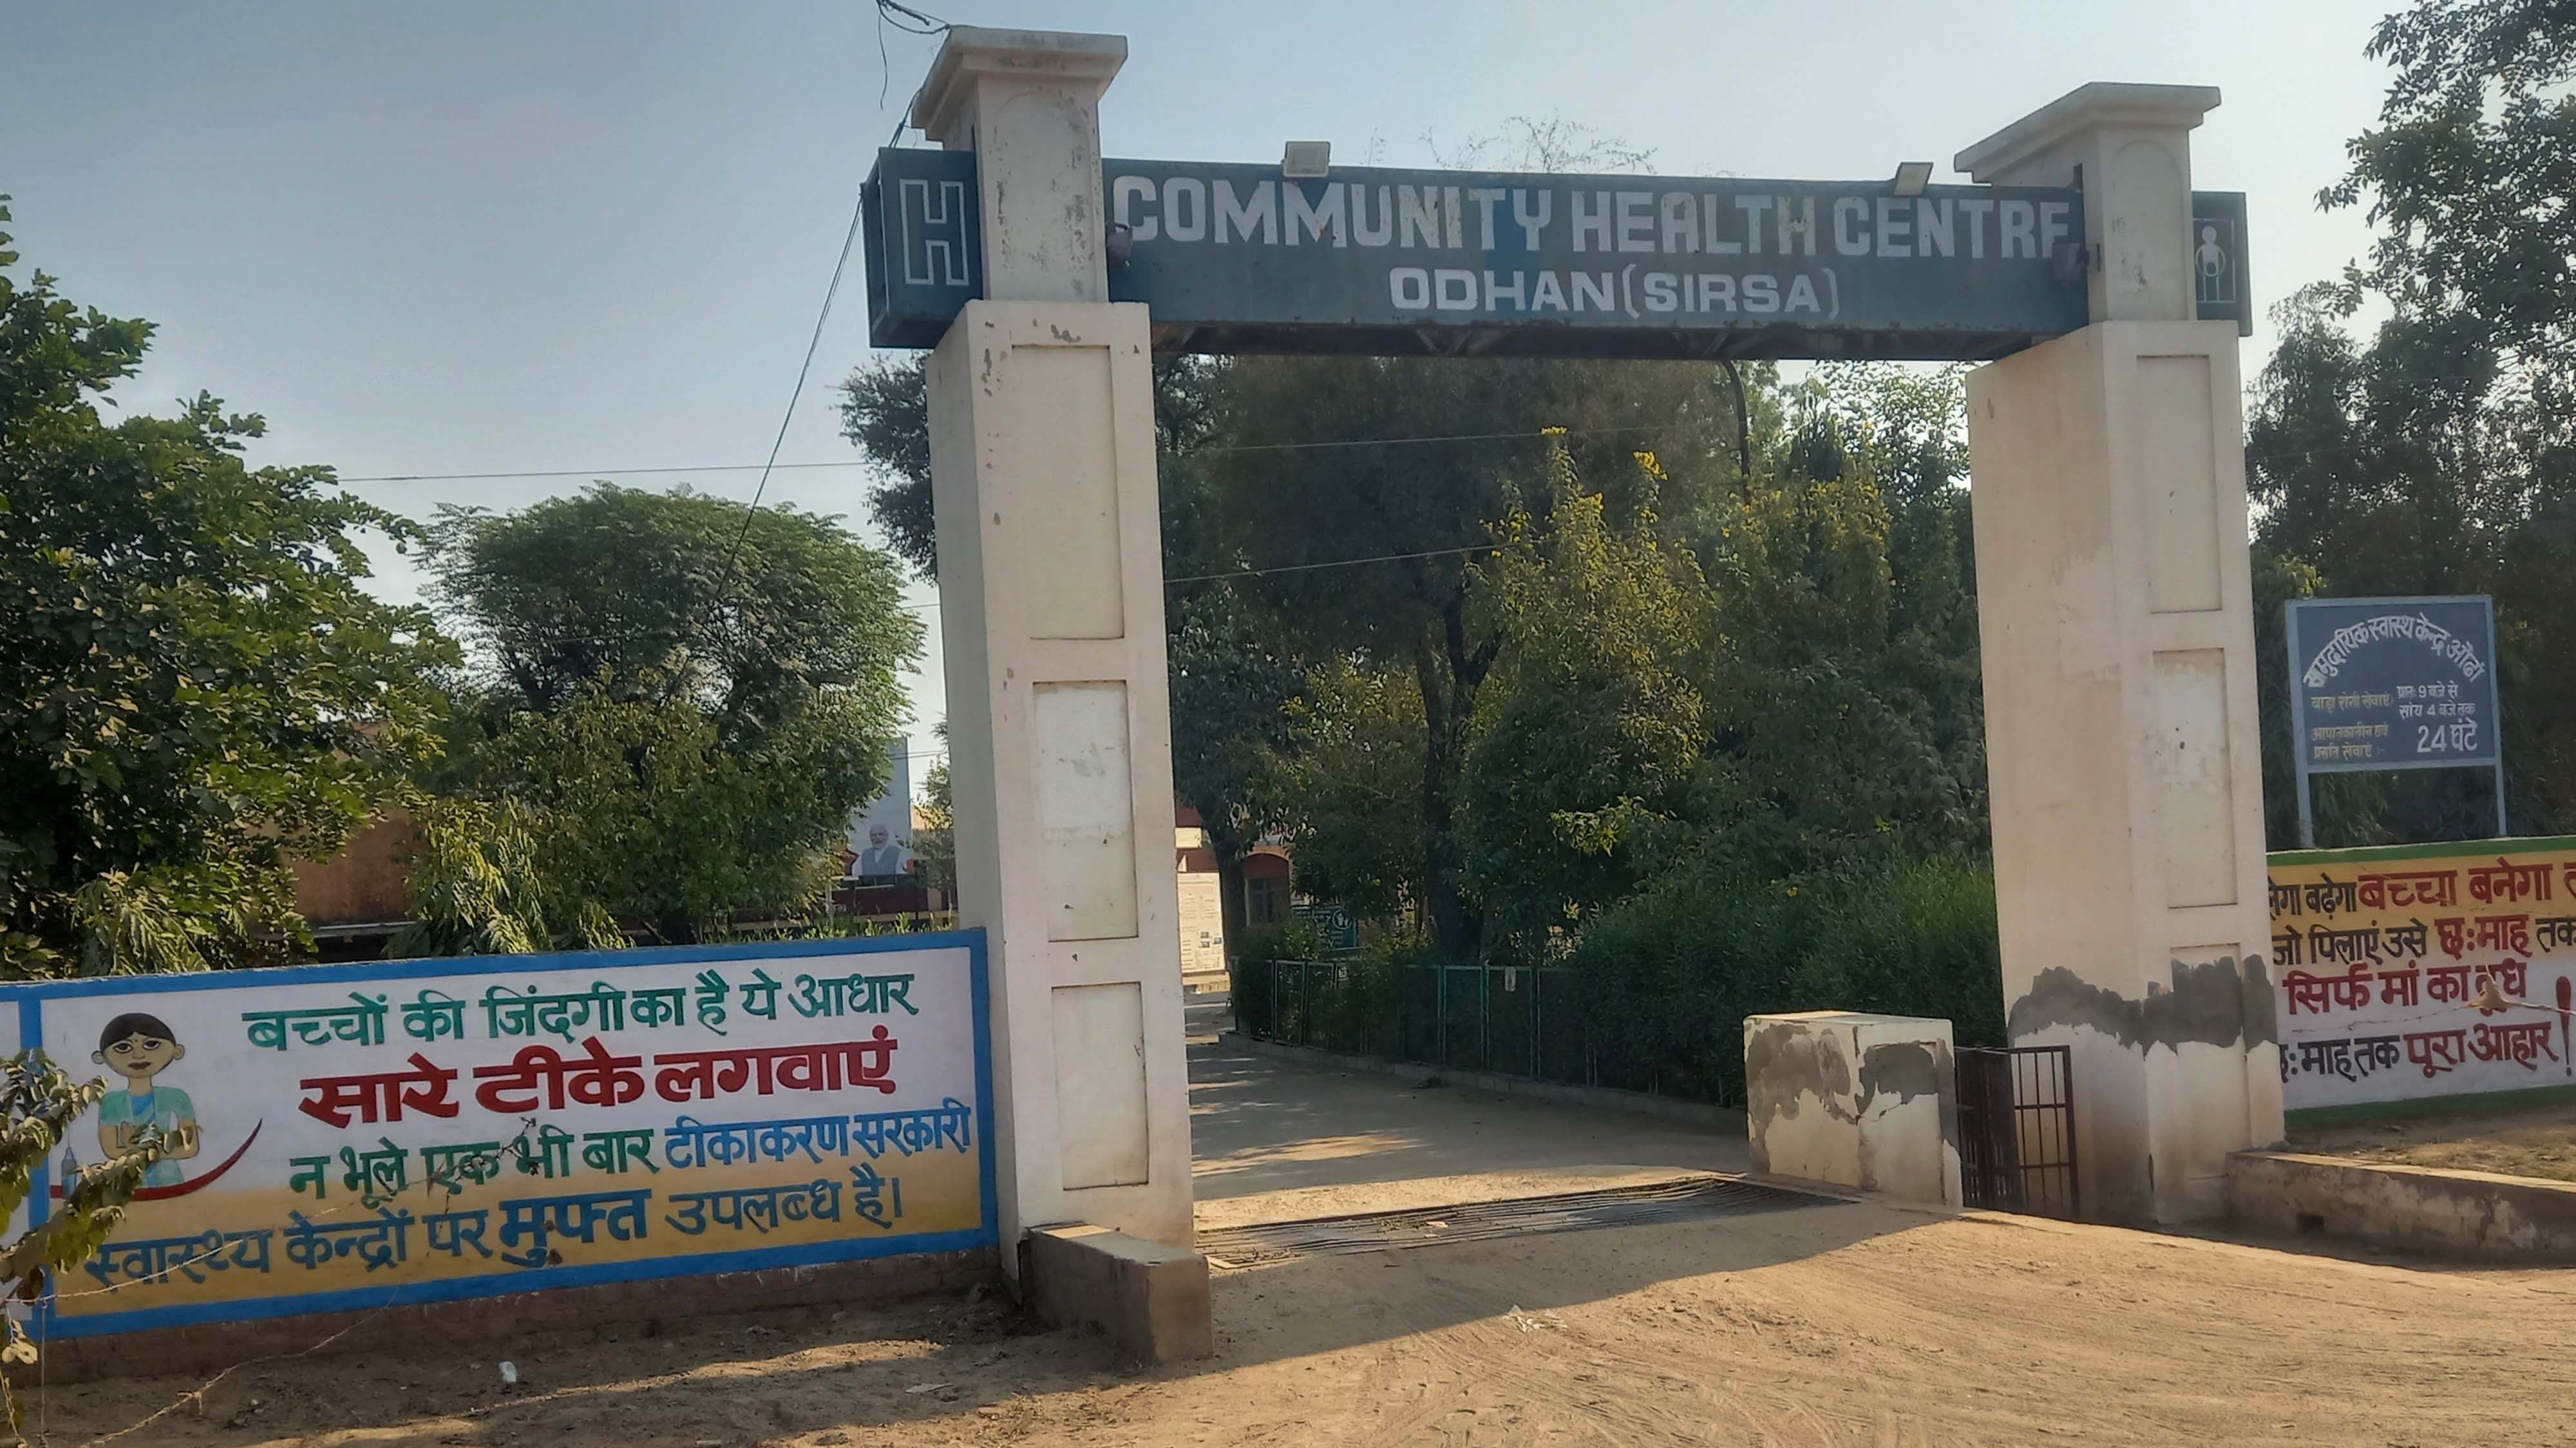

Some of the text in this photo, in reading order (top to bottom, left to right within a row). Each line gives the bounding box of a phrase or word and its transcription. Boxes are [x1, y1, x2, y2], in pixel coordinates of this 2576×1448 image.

[1113, 175, 2070, 258] COMMUNITY HEALTH CENTRE
[2418, 686, 2427, 698] 9
[2427, 704, 2436, 716] 4
[2417, 716, 2478, 753] 24 घंटे
[2304, 873, 2357, 920] बढ़ेगा
[2358, 870, 2458, 910] बच्चा
[2468, 857, 2553, 904] बनेगा
[2308, 920, 2383, 966] पिलाएं
[2382, 917, 2428, 958] उसे
[242, 968, 919, 1051] बच्चों की जिंदगी का है ये आधार
[2282, 962, 2373, 1015] सिर्फ
[2378, 960, 2420, 1007] मां
[2427, 966, 2472, 1002] का
[299, 1024, 898, 1129] सारे टीके लगवाएं
[2403, 1029, 2467, 1079] पूरा
[289, 1097, 972, 1209] न भूले एक भी बार टीकाकरण सरकारी
[84, 1227, 274, 1293] स्वास्थ्य
[284, 1208, 414, 1273] केन्द्रों
[421, 1208, 493, 1259] पर
[499, 1188, 652, 1268] मुफ्त
[665, 1177, 842, 1234] उपलब्ध
